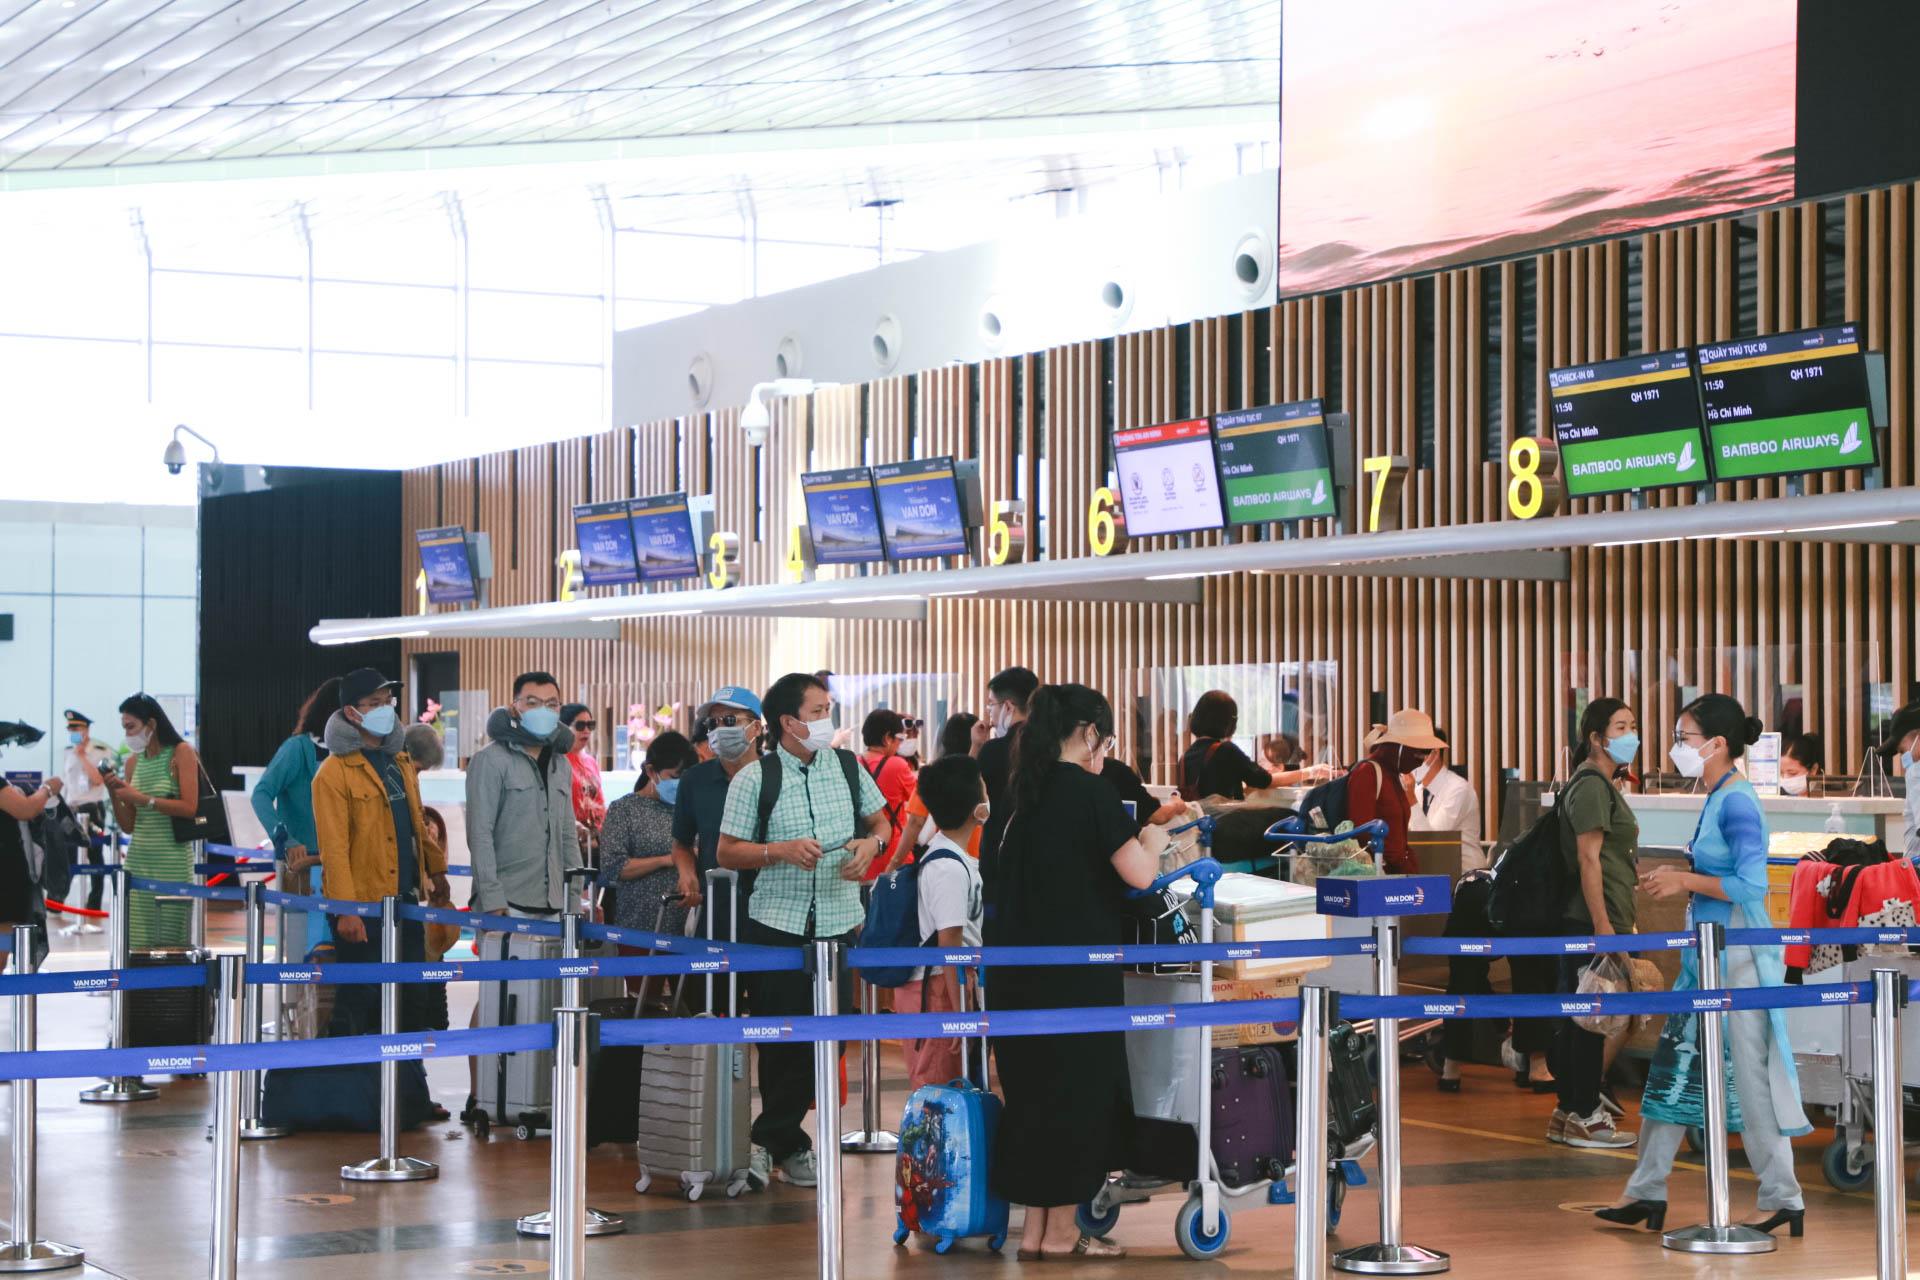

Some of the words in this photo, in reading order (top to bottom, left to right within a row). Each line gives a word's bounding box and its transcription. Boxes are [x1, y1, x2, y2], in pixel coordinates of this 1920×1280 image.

[1744, 344, 1758, 355] TỤC
[1758, 343, 1767, 352] 09
[1558, 371, 1585, 383] CHECK-IN
[1790, 369, 1803, 380] QH
[1805, 366, 1823, 377] 1971
[1704, 379, 1724, 391] 11:50
[1631, 391, 1642, 402] QH
[1644, 389, 1659, 400] 1971
[1555, 402, 1573, 413] 11:50
[1733, 404, 1752, 416] Minh
[1569, 428, 1580, 439] Chi
[1581, 426, 1599, 437] Minh
[1722, 441, 1778, 458] BAMBOO
[1782, 433, 1840, 451] AIRWAYS
[1572, 459, 1622, 476] BAMBOO
[1625, 452, 1676, 469] AIRWAYS
[1508, 436, 1543, 519] 8
[1232, 492, 1271, 507] BAMBOO
[1273, 488, 1312, 503] AIRWAYS
[1363, 456, 1392, 532] 7
[901, 505, 919, 519] VAN
[918, 503, 937, 518] DON
[1088, 487, 1116, 556] 6
[988, 501, 1010, 565] 5
[787, 527, 803, 581] 4
[709, 532, 728, 590] 3
[559, 550, 574, 602] 2
[416, 568, 426, 616] 1
[1385, 895, 1399, 903] VAN
[1400, 894, 1414, 902] DON
[91, 978, 108, 986] DON
[1821, 992, 1835, 1000] VAN
[1424, 1004, 1439, 1012] VAN
[1439, 1004, 1455, 1012] DON
[1561, 1002, 1576, 1010] VAN
[1576, 1002, 1591, 1010] DON
[1131, 1015, 1147, 1023] VAN
[1147, 1014, 1165, 1022] DON
[743, 1027, 761, 1035] VAN
[761, 1027, 780, 1035] DON
[942, 1022, 959, 1031] VAN
[960, 1021, 978, 1030] DON
[1261, 1025, 1266, 1034] 2
[381, 1045, 401, 1053] VAN
[402, 1043, 422, 1052] DON
[148, 1058, 169, 1066] VAN
[170, 1057, 192, 1066] DON
